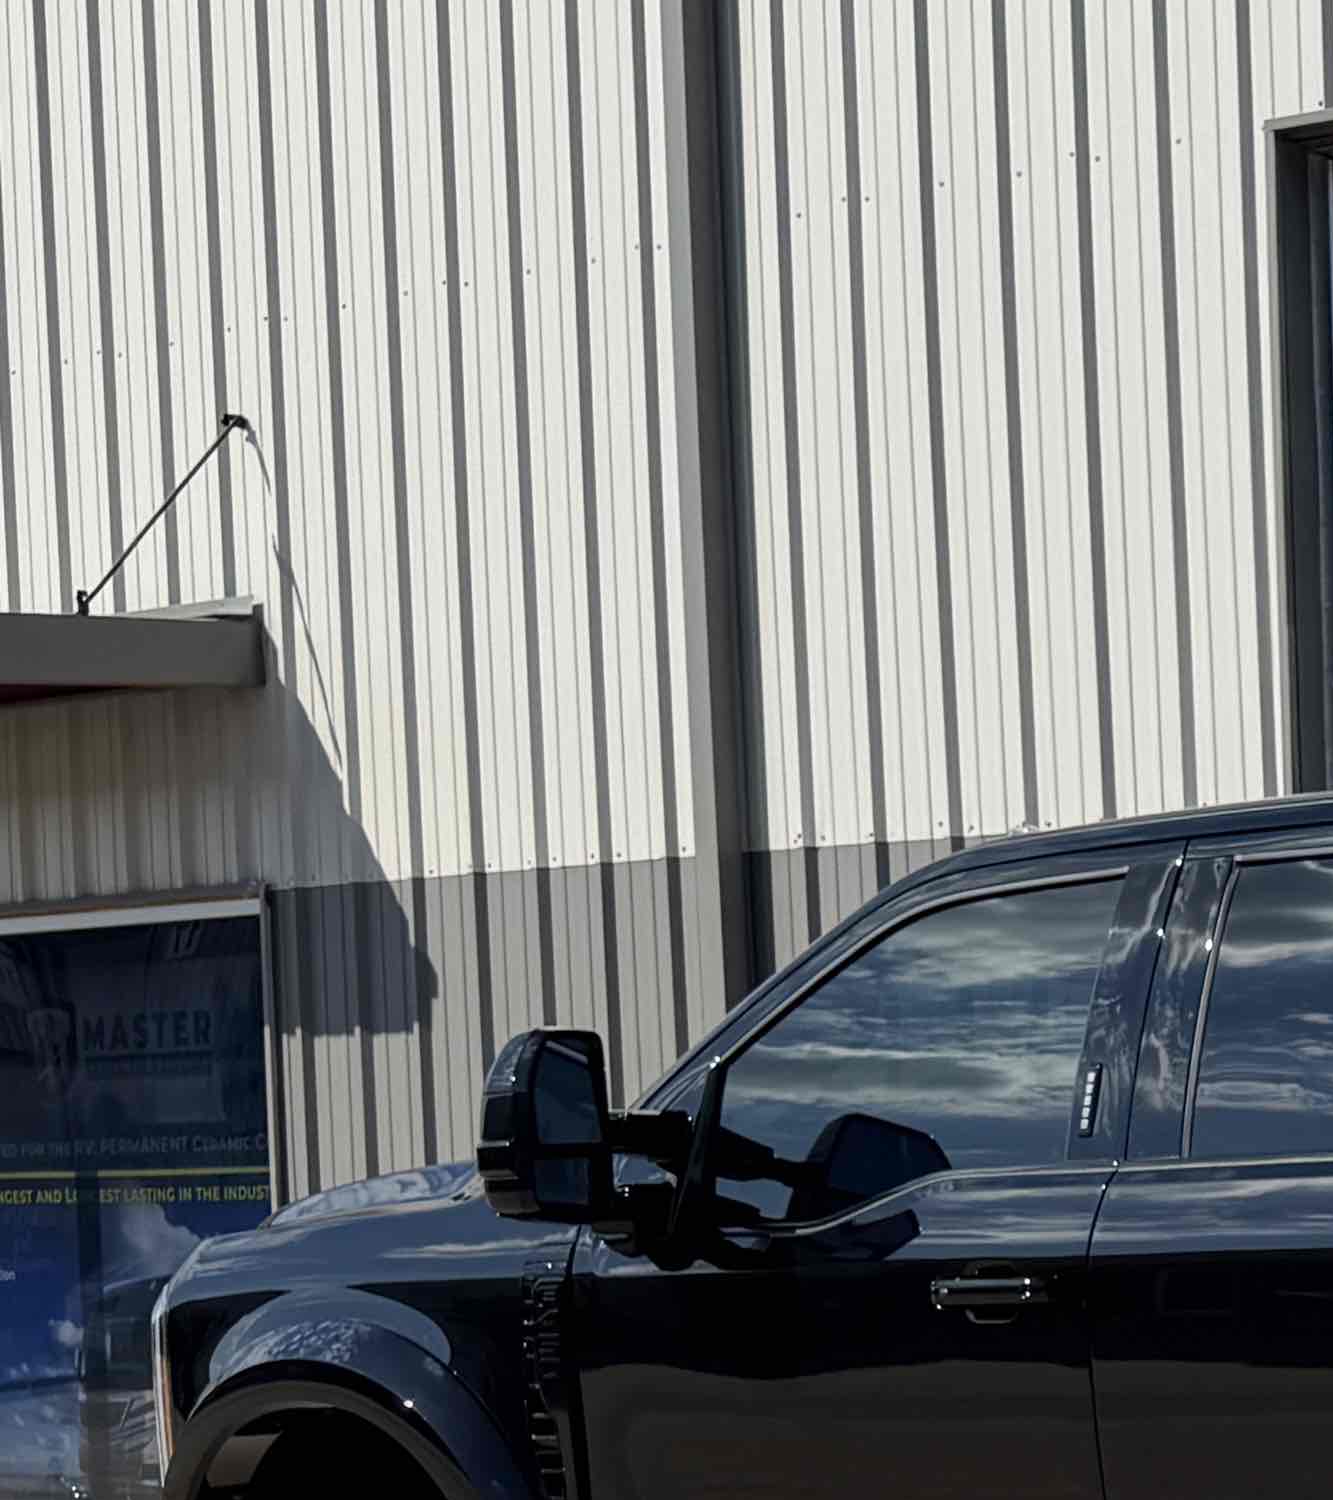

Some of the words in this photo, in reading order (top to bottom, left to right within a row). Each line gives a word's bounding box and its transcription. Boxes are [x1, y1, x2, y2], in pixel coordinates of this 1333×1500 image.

[82, 1008, 211, 1050] MASTER
[36, 1186, 63, 1203] AND
[124, 1184, 176, 1203] LASTING
[178, 1185, 192, 1201] IN
[196, 1185, 221, 1201] THE
